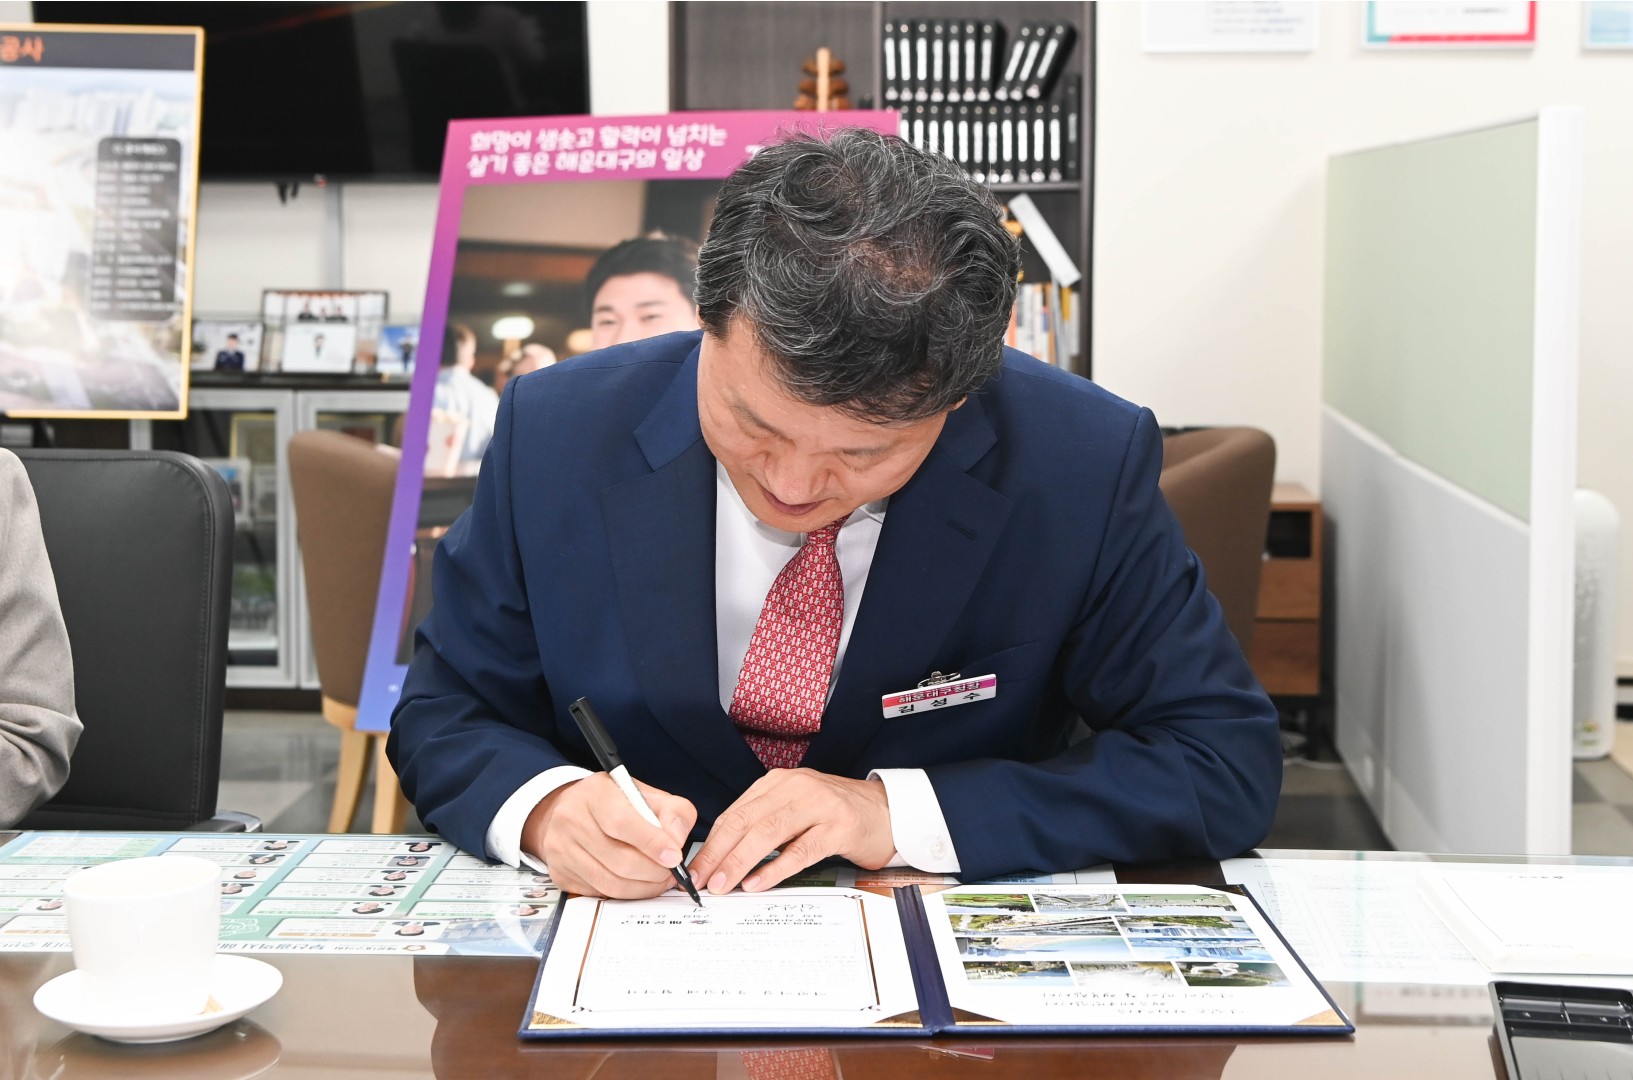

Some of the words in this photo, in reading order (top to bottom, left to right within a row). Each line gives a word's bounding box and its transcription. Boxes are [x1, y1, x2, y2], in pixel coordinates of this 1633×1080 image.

[470, 130, 531, 153] 희망이
[536, 127, 594, 151] 샘솟고
[599, 124, 661, 149] 활력이
[666, 122, 727, 147] 넘치는
[467, 153, 508, 177] 살기
[513, 150, 550, 176] 좋은
[555, 148, 656, 173] 해운대구의
[661, 147, 705, 171] 일상
[898, 681, 981, 702] 해운대구청장
